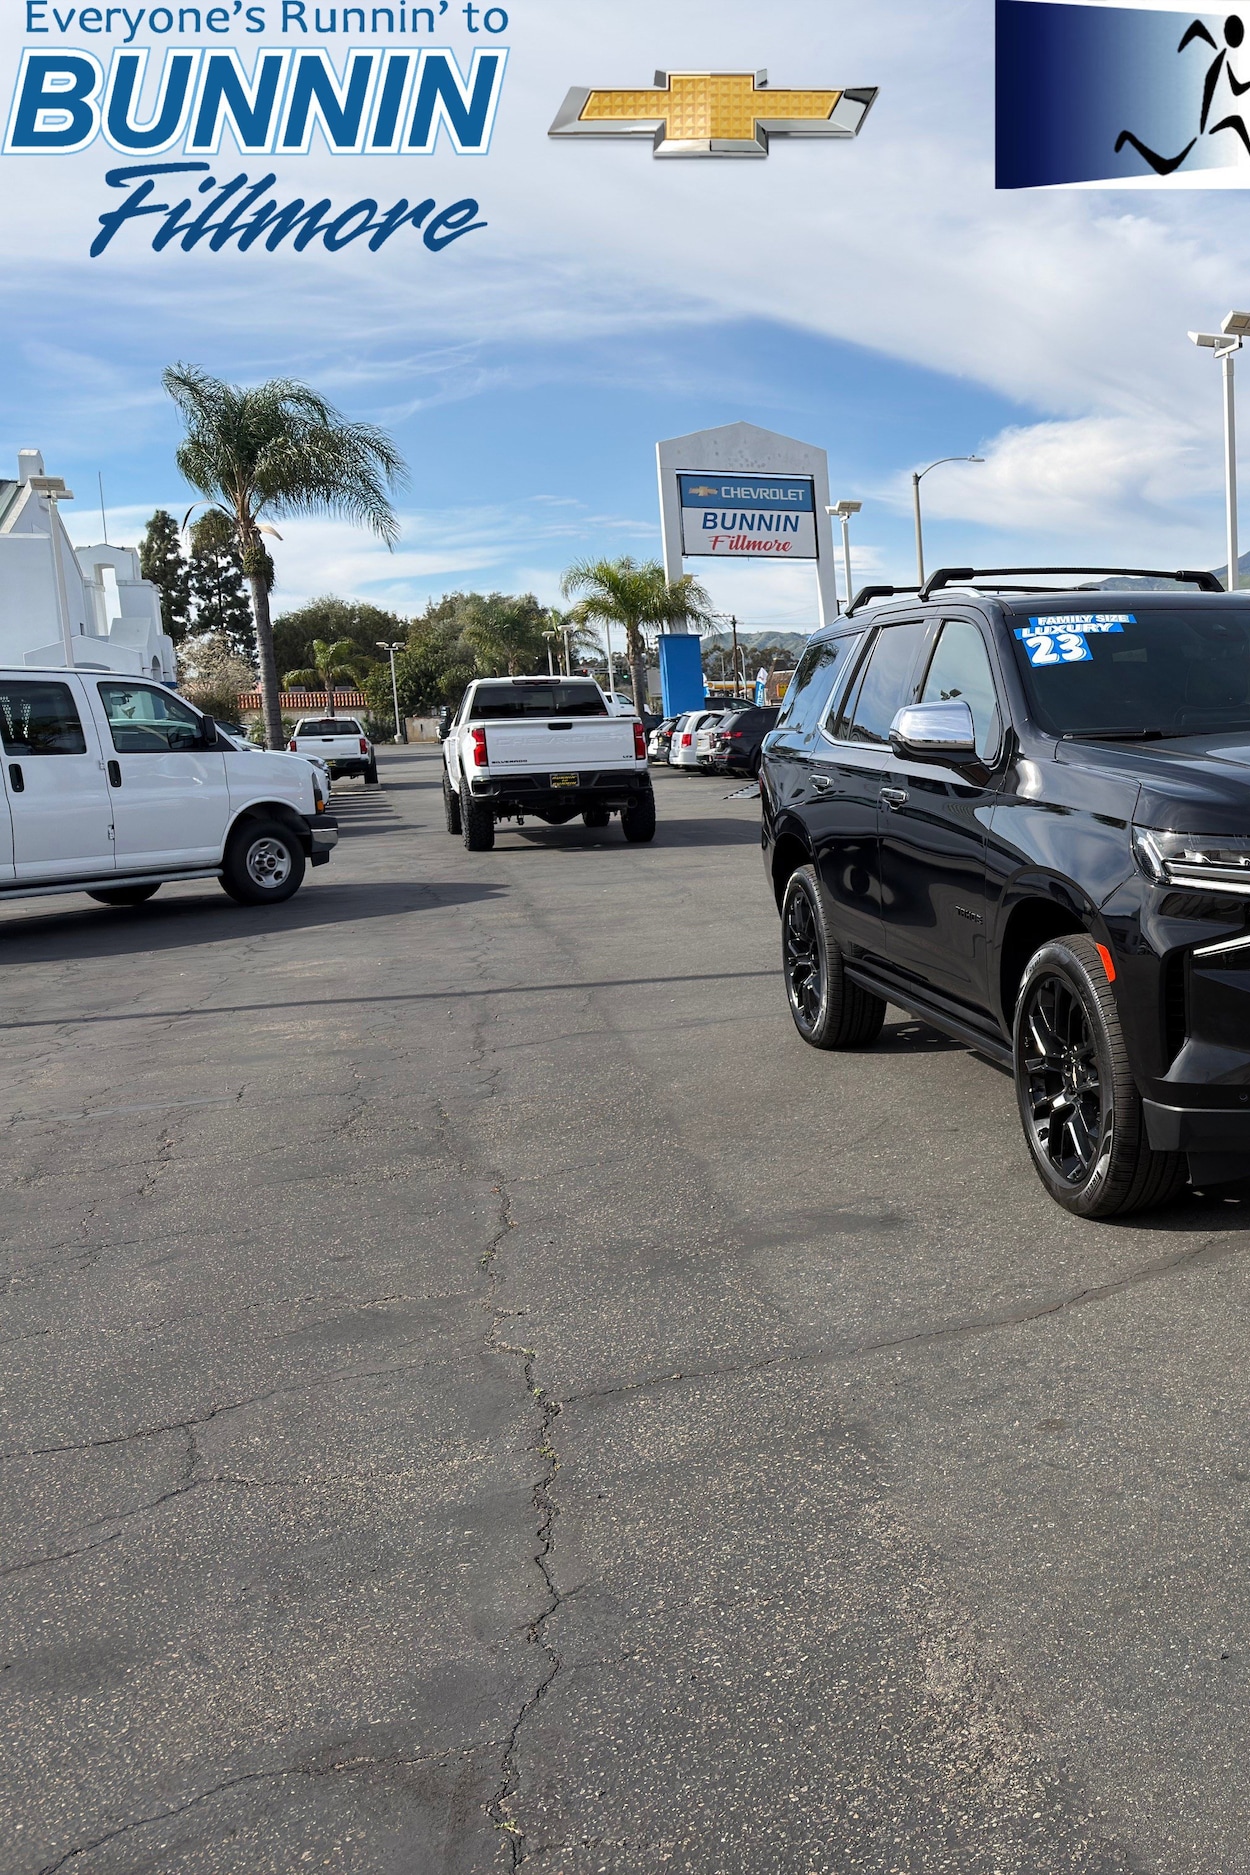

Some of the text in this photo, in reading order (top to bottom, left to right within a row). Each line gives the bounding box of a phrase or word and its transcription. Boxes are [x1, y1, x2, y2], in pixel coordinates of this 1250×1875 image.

[721, 486, 805, 500] CHEVROLET
[702, 512, 799, 532] BUNNIN
[708, 535, 793, 552] Fillmore
[1037, 614, 1130, 626] FAMILY SIZE
[1021, 623, 1114, 638] LUXURY
[1026, 633, 1087, 664] 23
